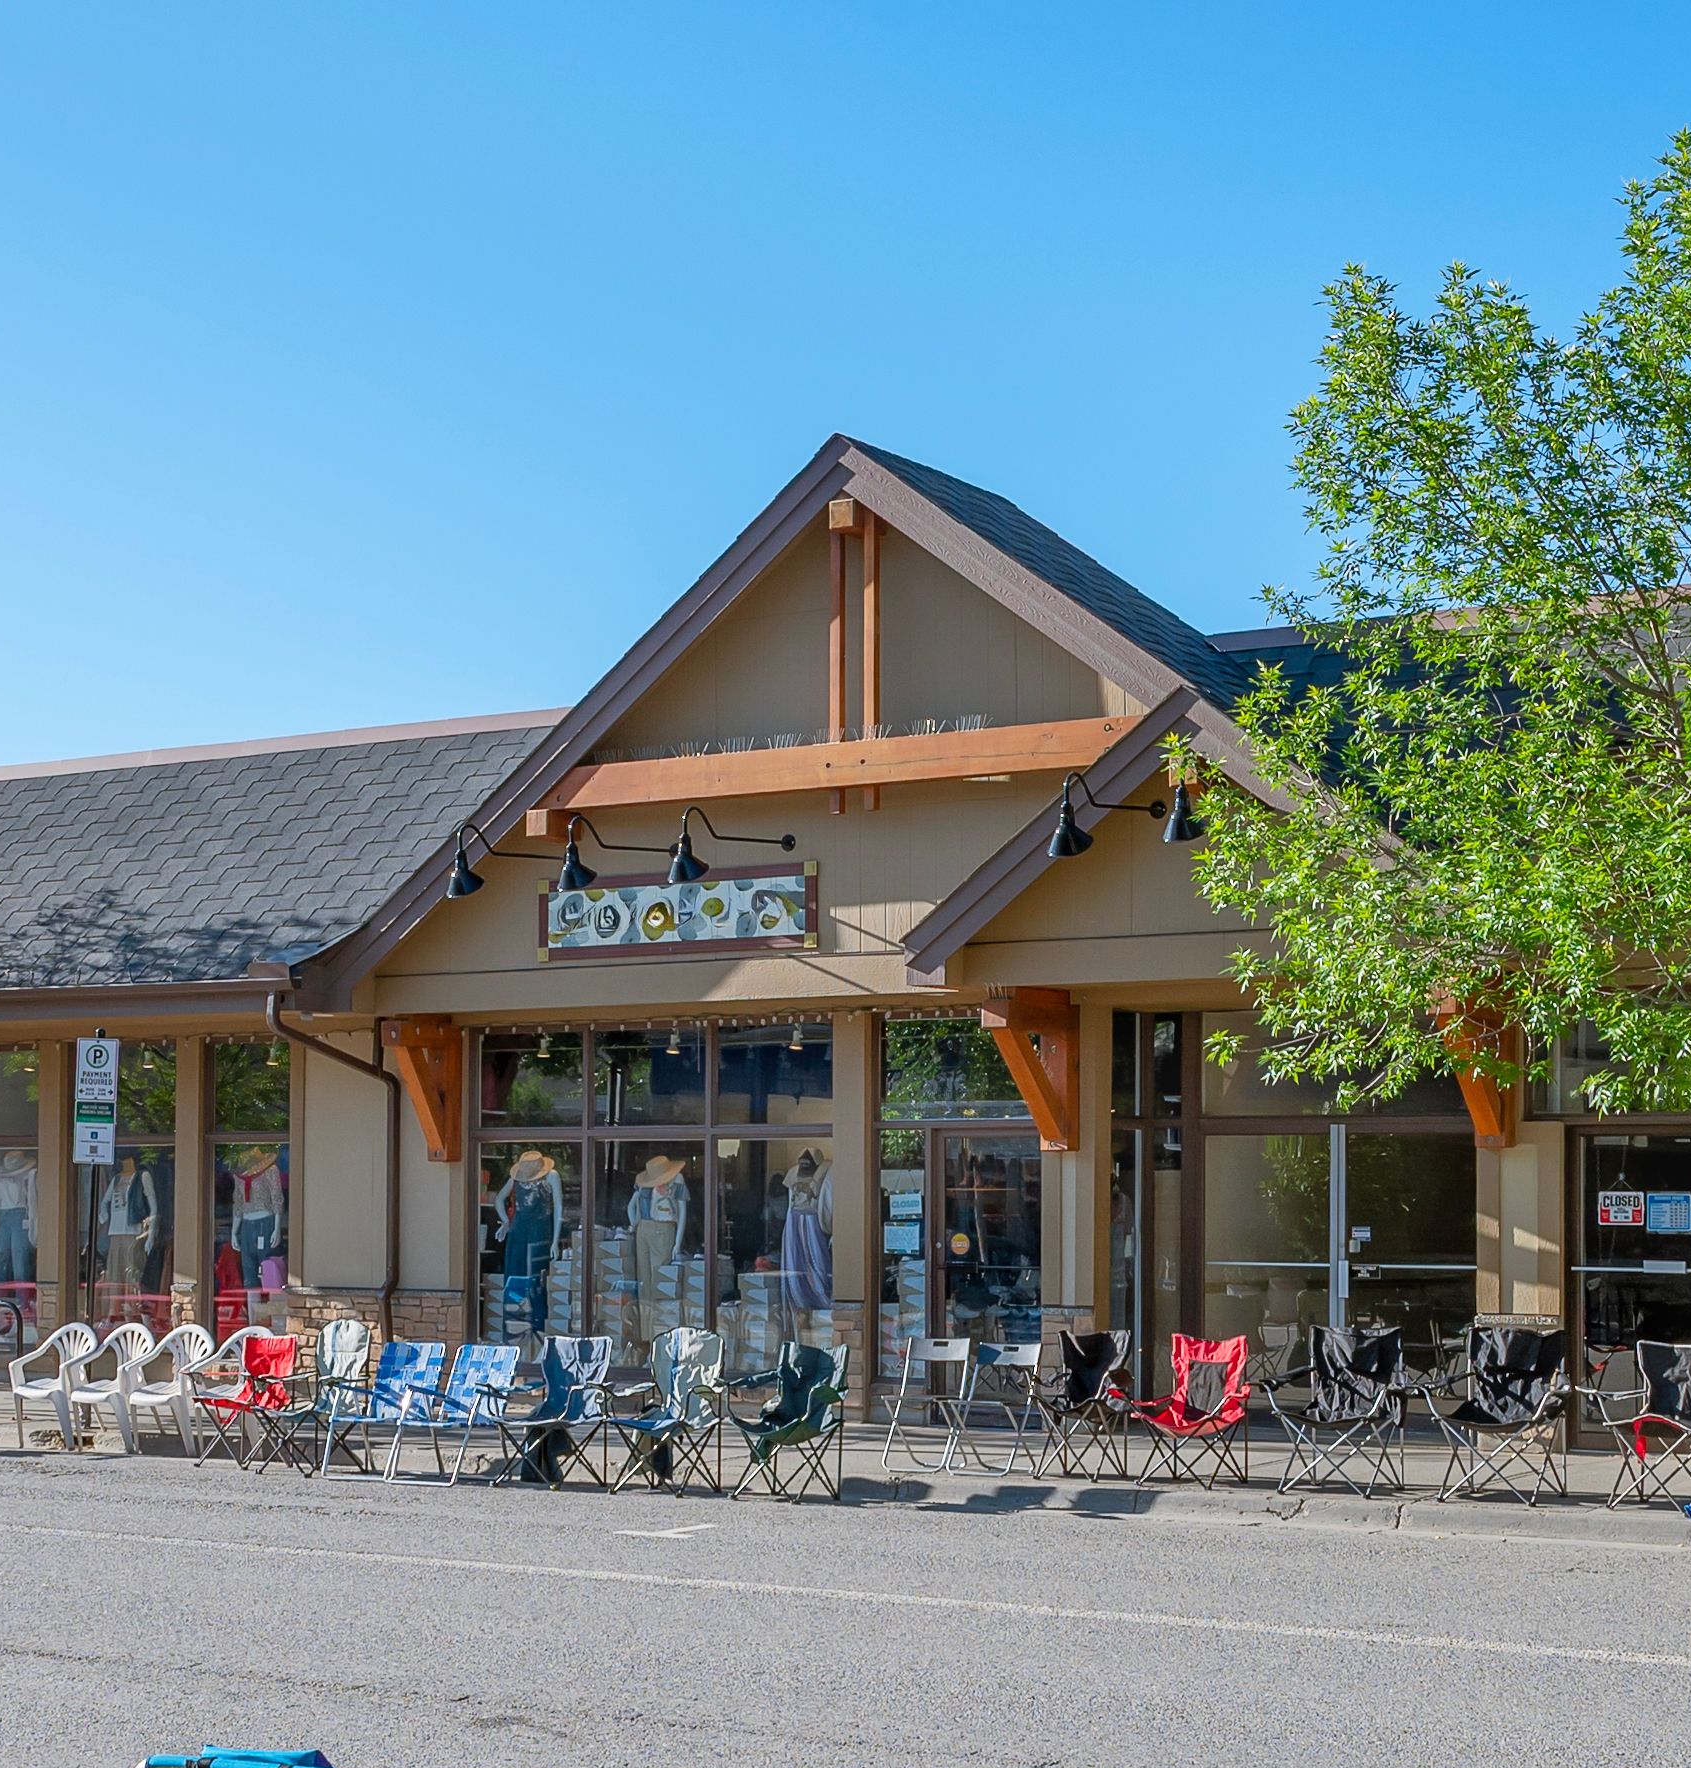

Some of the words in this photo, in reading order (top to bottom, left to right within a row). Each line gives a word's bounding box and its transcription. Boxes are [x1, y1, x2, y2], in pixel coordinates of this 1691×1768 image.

[93, 1048, 103, 1065] P
[82, 1070, 112, 1079] PAYMENT
[80, 1078, 113, 1086] REQUIRED
[891, 1200, 920, 1209] CLOSED
[1602, 1195, 1640, 1208] CLOSED
